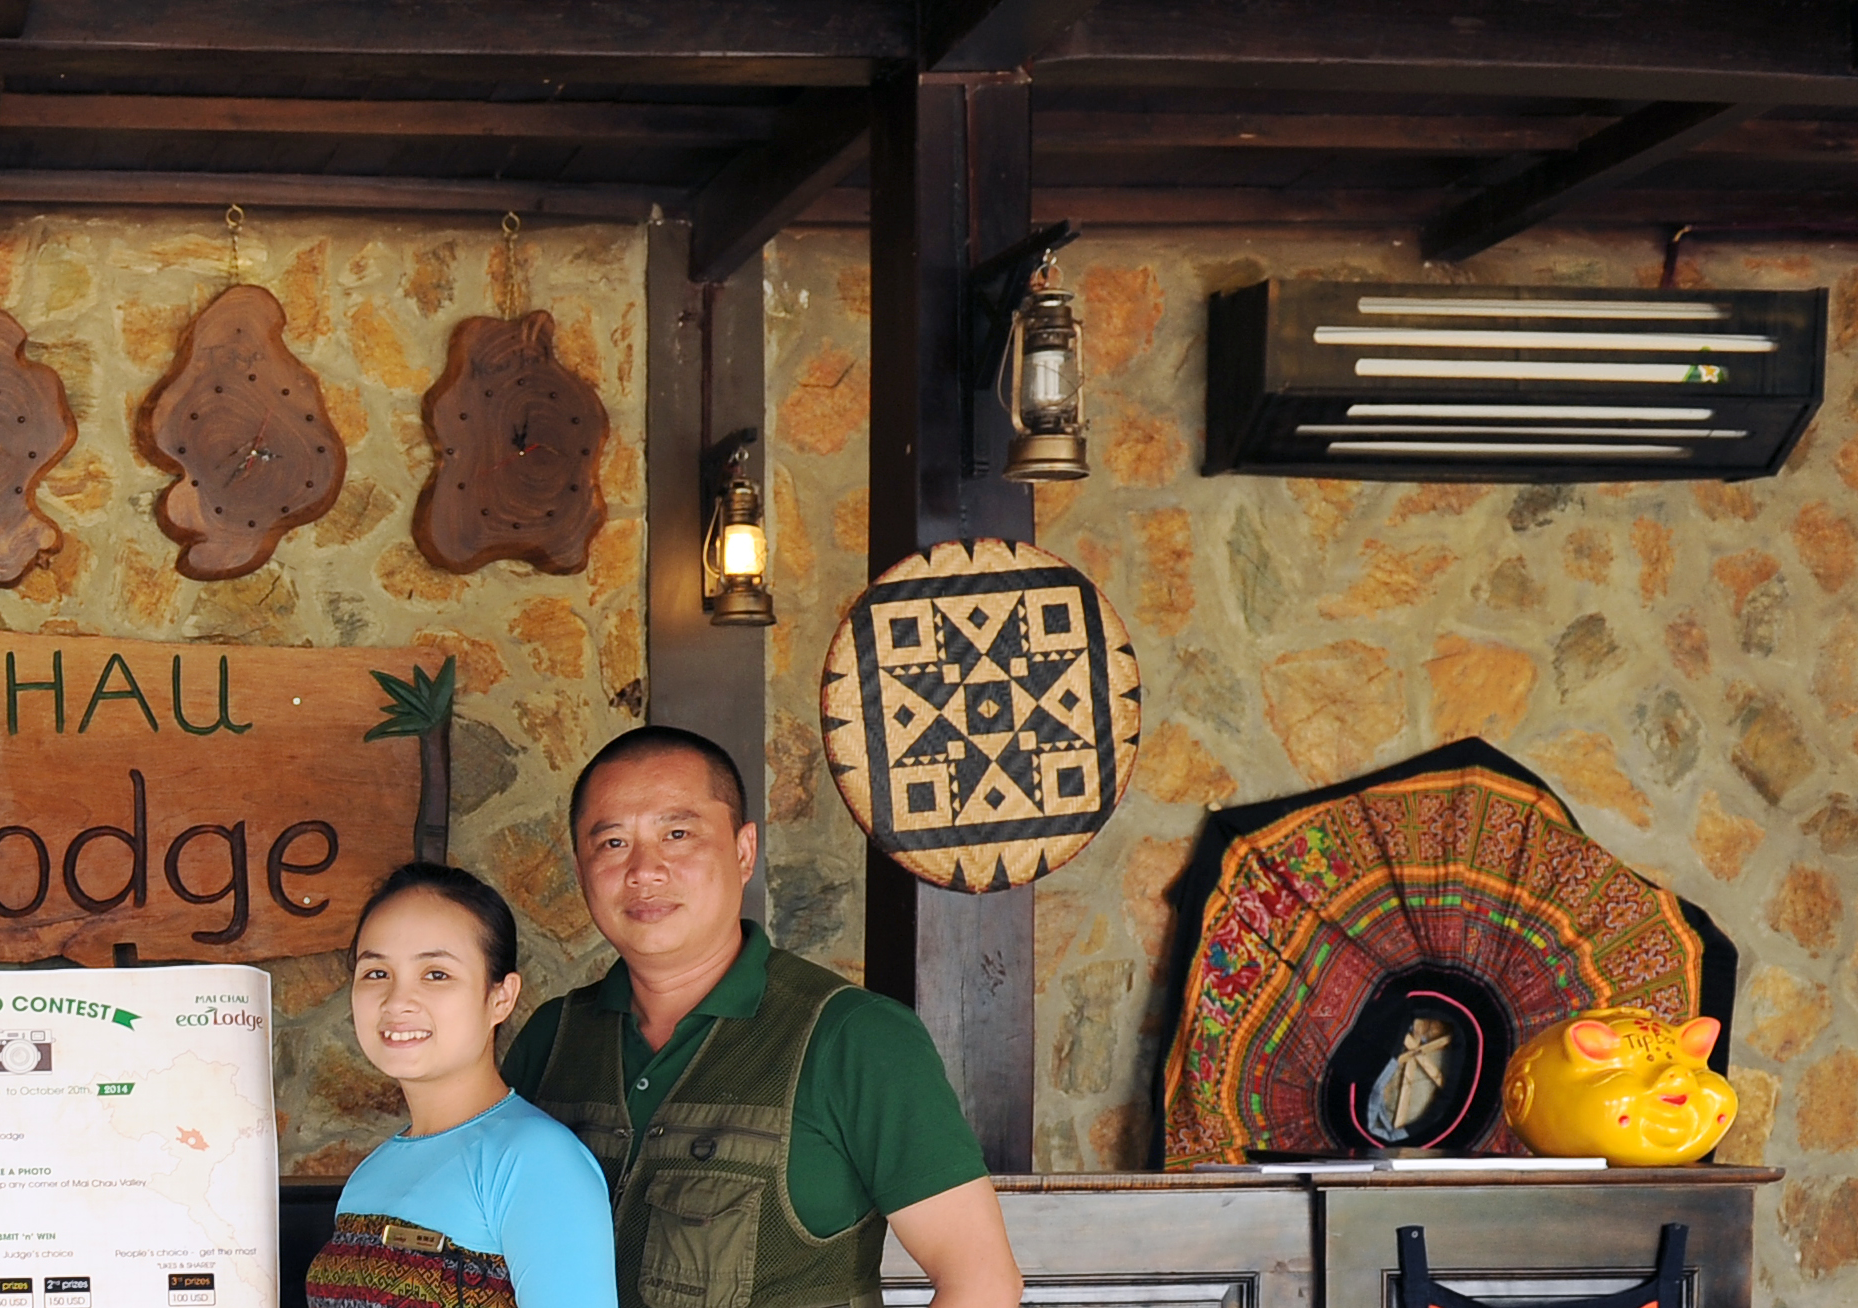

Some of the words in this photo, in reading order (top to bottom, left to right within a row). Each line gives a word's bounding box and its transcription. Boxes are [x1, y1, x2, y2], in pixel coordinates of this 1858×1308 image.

[194, 994, 218, 1004] MAI
[220, 994, 249, 1004] CHAU
[11, 995, 112, 1021] CONTEST
[1623, 1033, 1653, 1052] Tip
[6, 1087, 17, 1096] to
[20, 1086, 65, 1096] October
[103, 1084, 128, 1094] 2014
[8, 1168, 15, 1176] A
[18, 1167, 52, 1176] PHOTO
[9, 1181, 25, 1189] any
[28, 1180, 58, 1188] corner
[60, 1179, 70, 1188] of
[72, 1179, 89, 1188] Mai
[92, 1179, 117, 1188] Chau
[119, 1178, 146, 1188] Valley
[37, 1232, 56, 1240] WIN
[41, 1249, 74, 1258] choice
[156, 1248, 189, 1257] choice
[199, 1248, 215, 1258] get
[217, 1247, 233, 1256] the
[234, 1247, 258, 1256] most
[2, 1281, 28, 1291] prizes
[61, 1279, 89, 1290] prizes
[184, 1276, 211, 1287] prizes
[9, 1297, 28, 1306] USD
[49, 1297, 64, 1306] 150
[66, 1296, 86, 1306] USD
[172, 1293, 188, 1302] 100
[190, 1293, 209, 1302] USD
